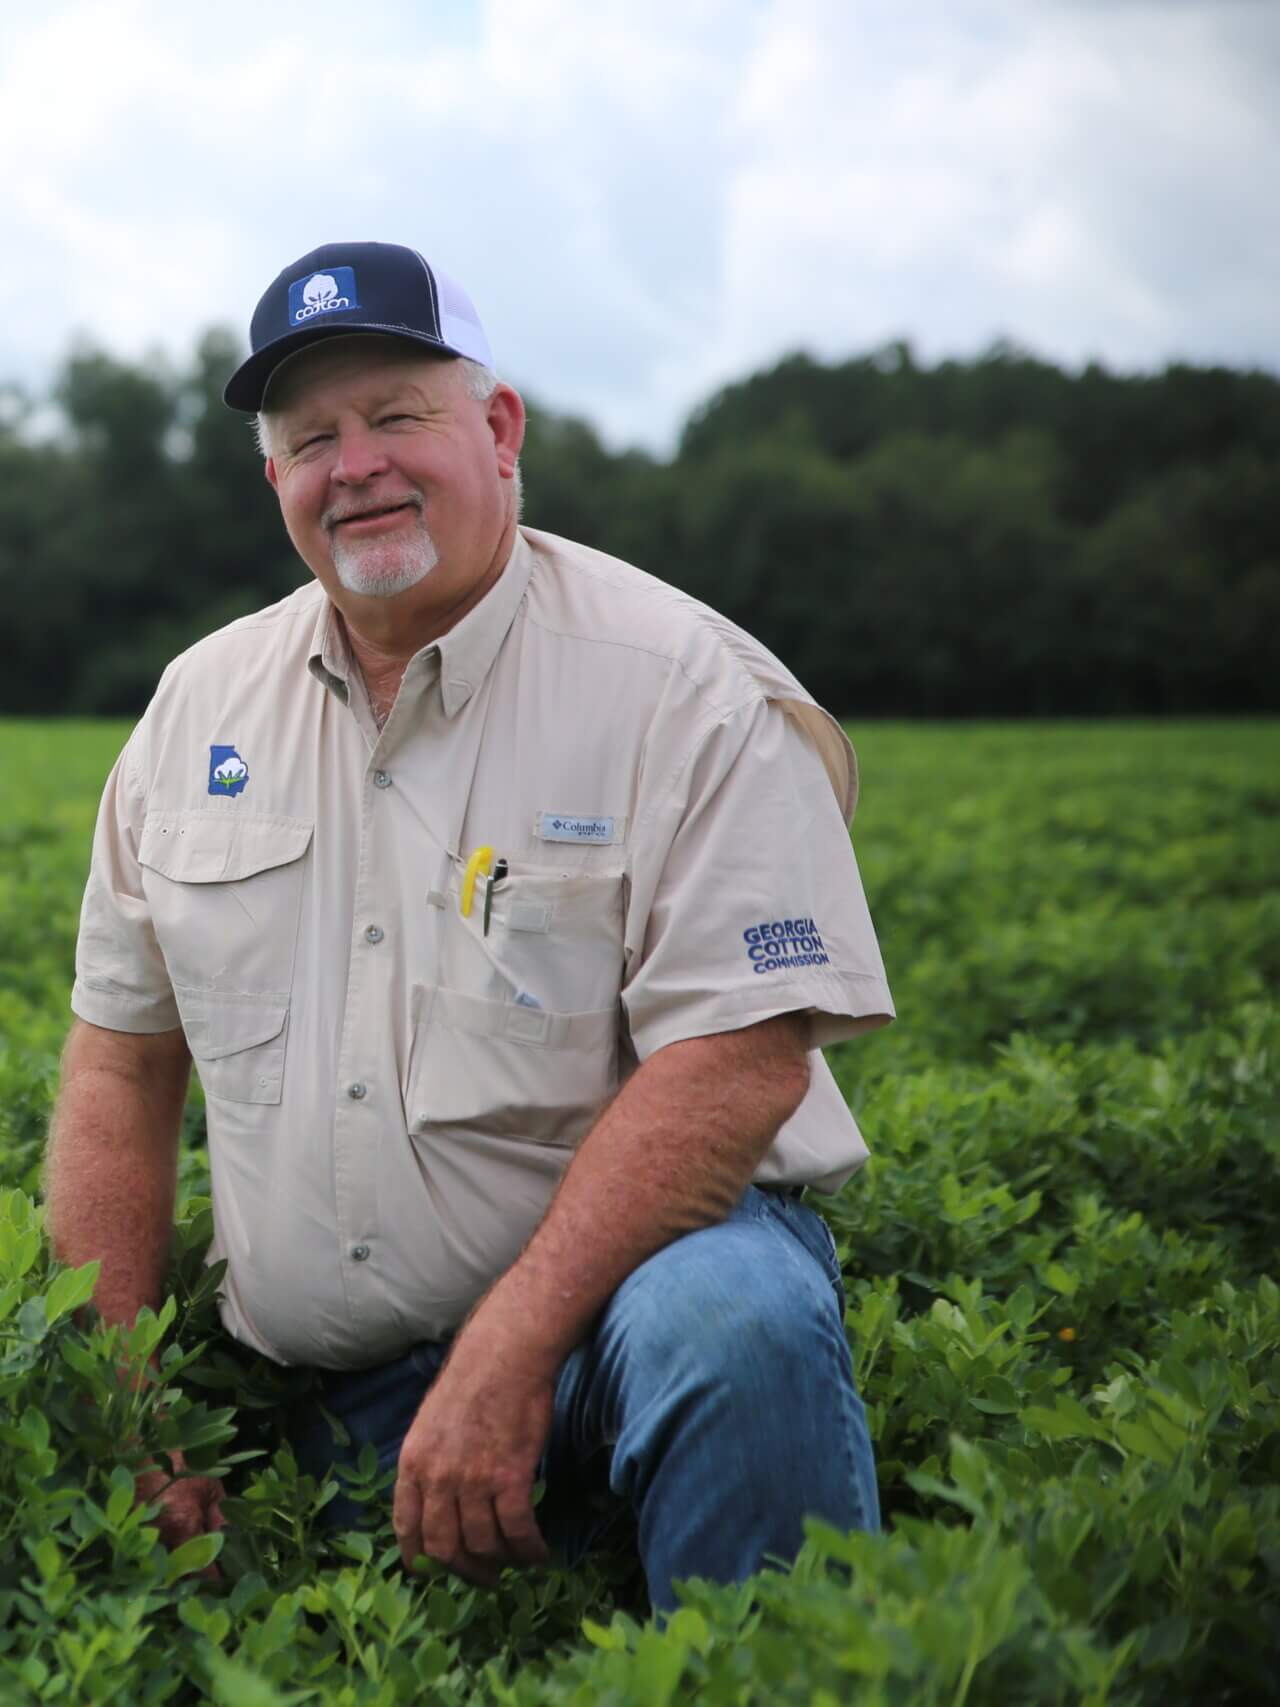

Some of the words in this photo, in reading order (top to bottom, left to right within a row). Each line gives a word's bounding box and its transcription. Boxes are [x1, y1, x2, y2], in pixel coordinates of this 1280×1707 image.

[295, 297, 349, 320] cotton
[562, 821, 606, 833] Columbia
[743, 918, 818, 944] GEORGIA
[748, 935, 824, 961] COTTON
[753, 953, 830, 975] COMMISSION
